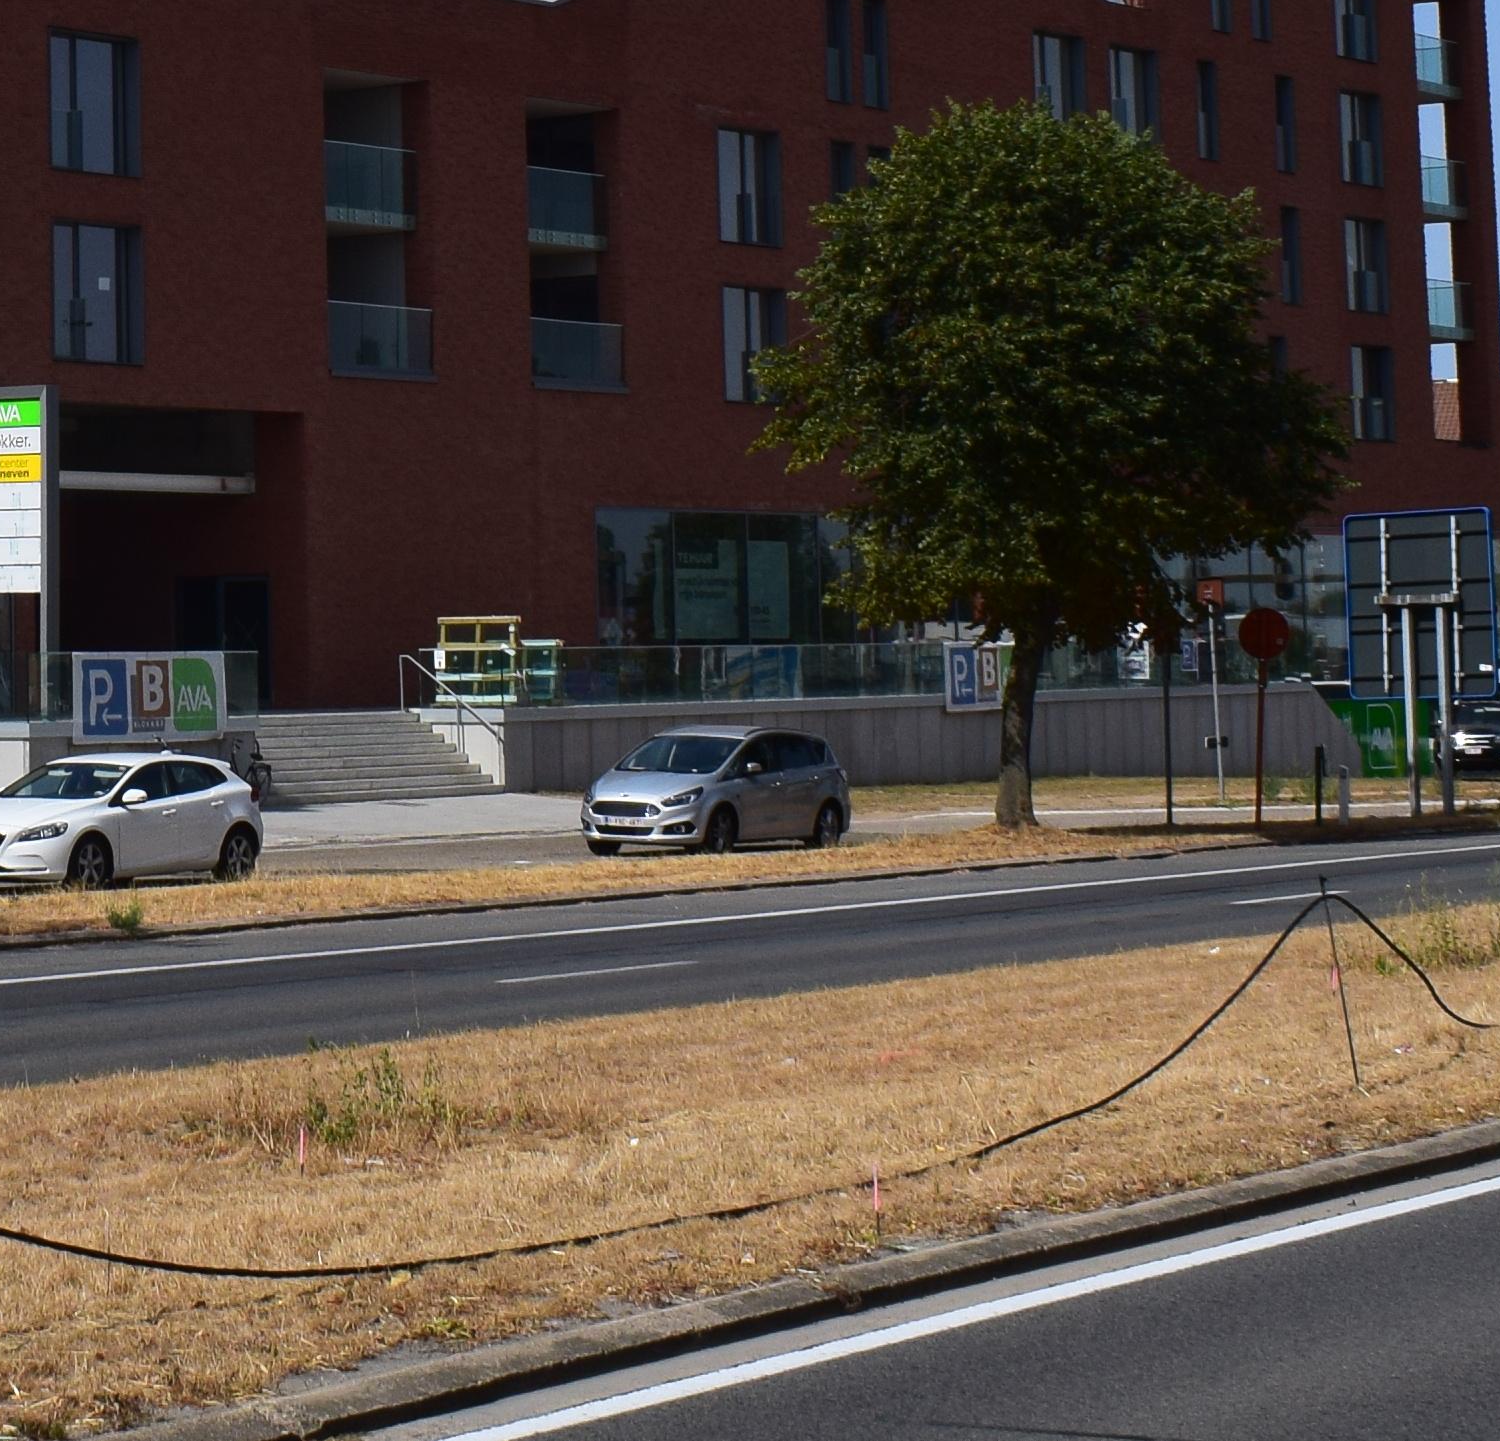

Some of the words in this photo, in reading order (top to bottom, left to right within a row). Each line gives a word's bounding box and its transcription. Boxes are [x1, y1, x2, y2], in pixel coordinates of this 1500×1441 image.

[0, 470, 29, 478] neven
[89, 669, 113, 726] P
[142, 665, 164, 711] B
[952, 654, 968, 698] P
[982, 651, 996, 687] B
[177, 684, 213, 712] AVA
